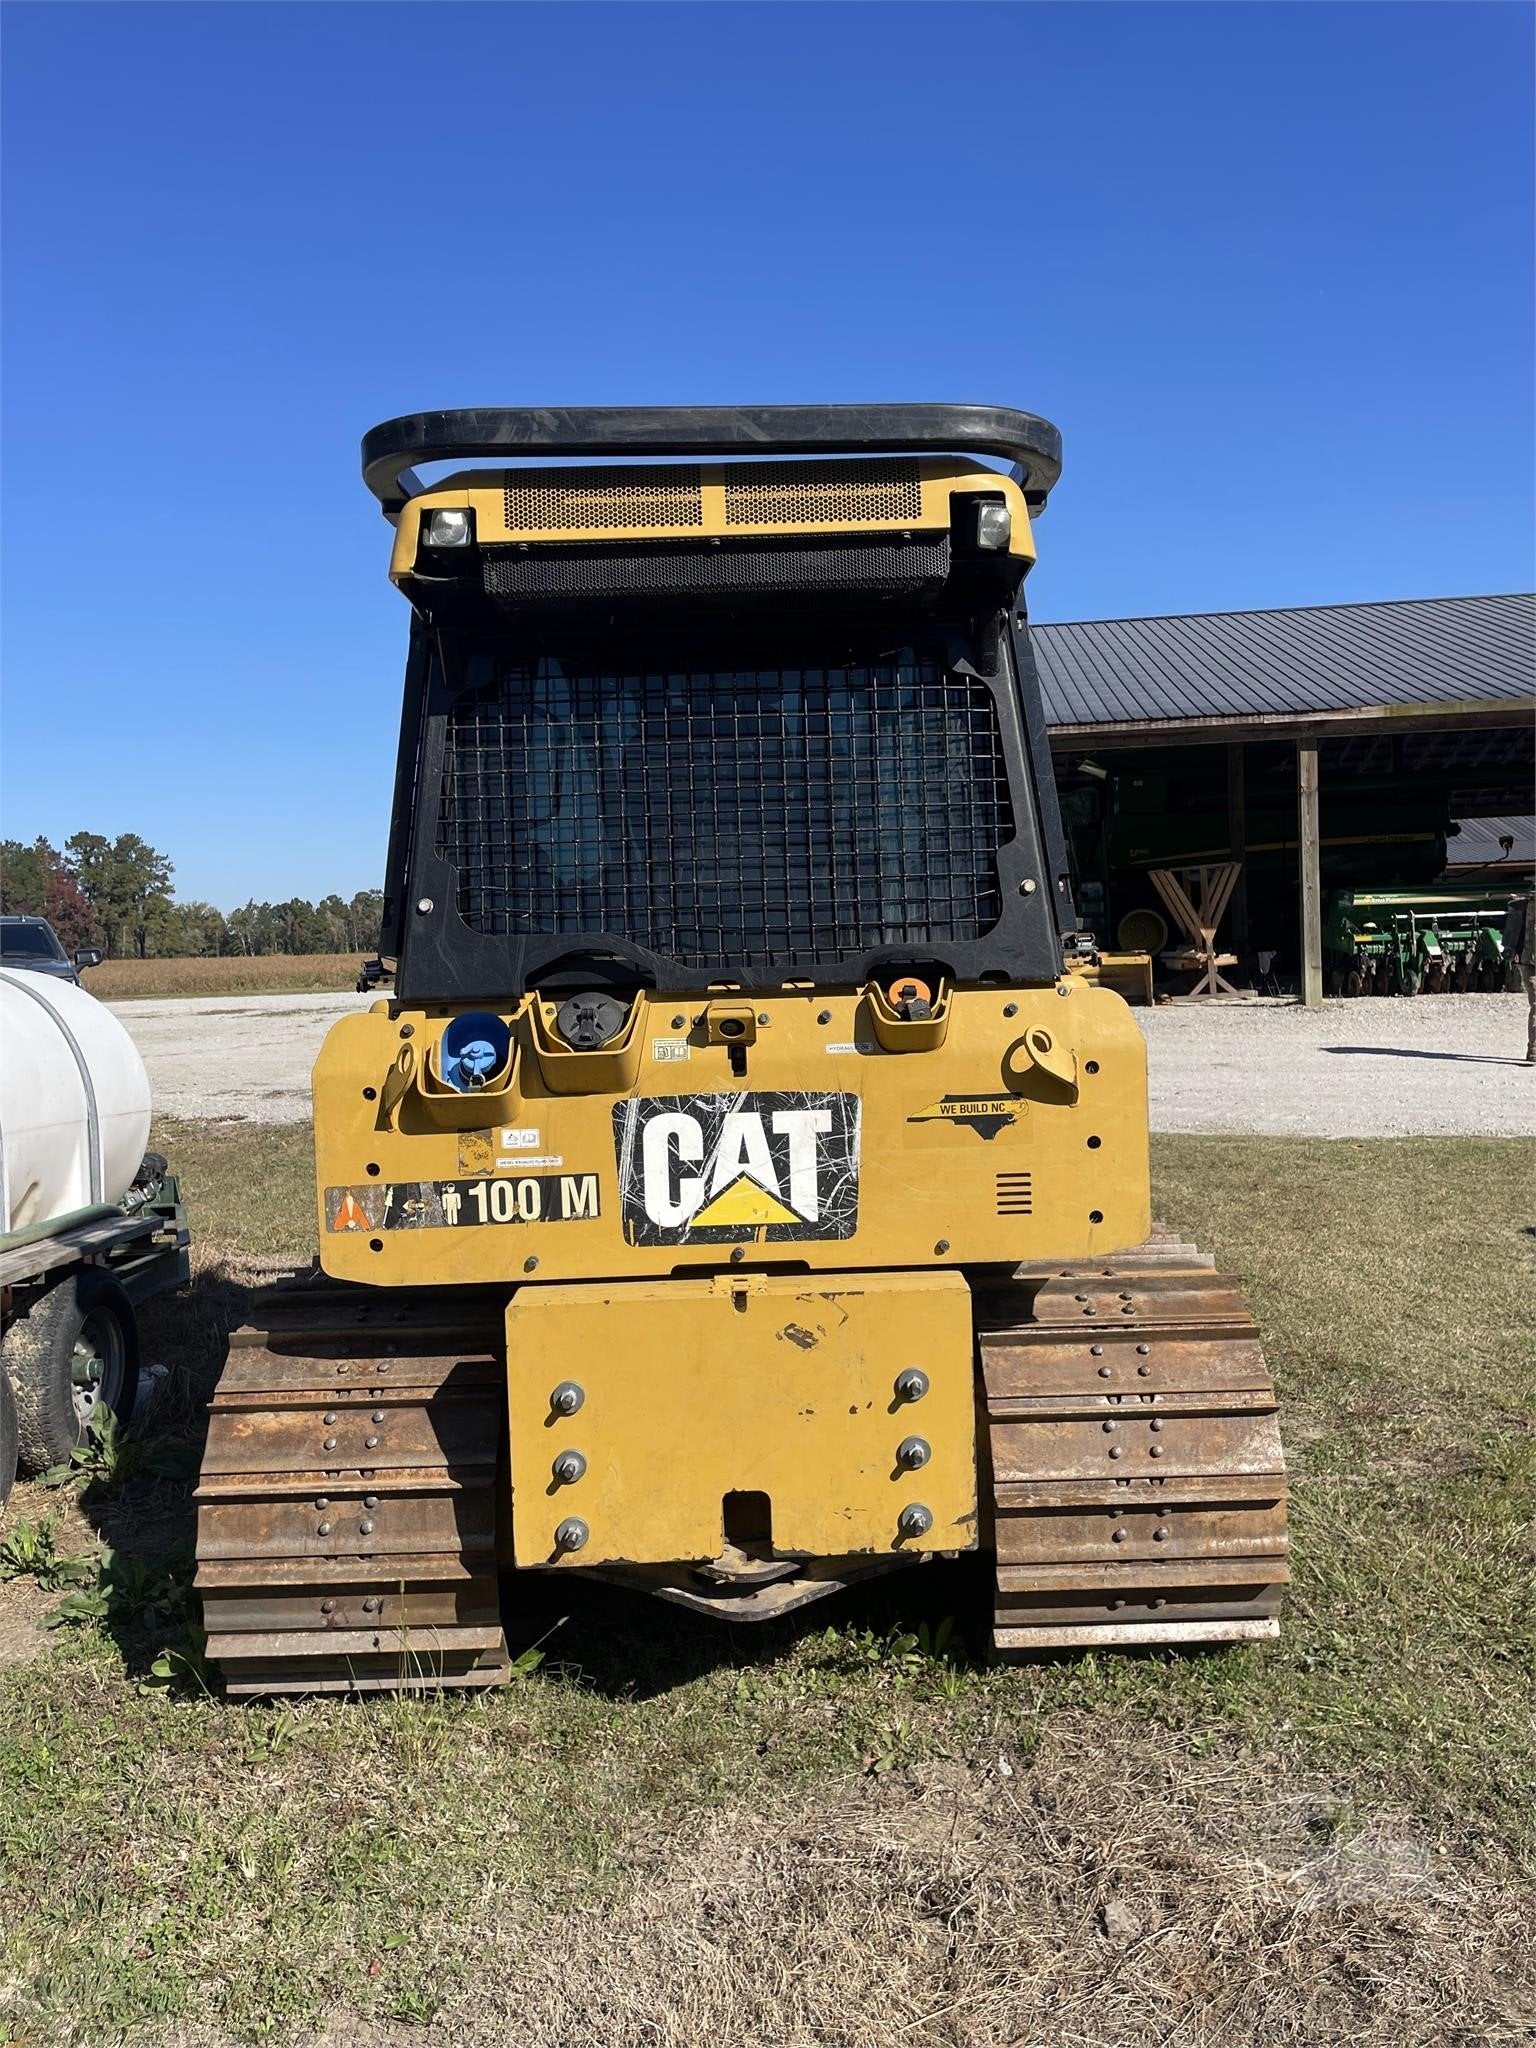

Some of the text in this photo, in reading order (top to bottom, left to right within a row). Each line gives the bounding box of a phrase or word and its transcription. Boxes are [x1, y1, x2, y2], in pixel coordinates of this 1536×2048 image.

[940, 1102, 1005, 1115] WE BUILD NC
[643, 1110, 832, 1227] CAT
[469, 1175, 598, 1223] 100 M
